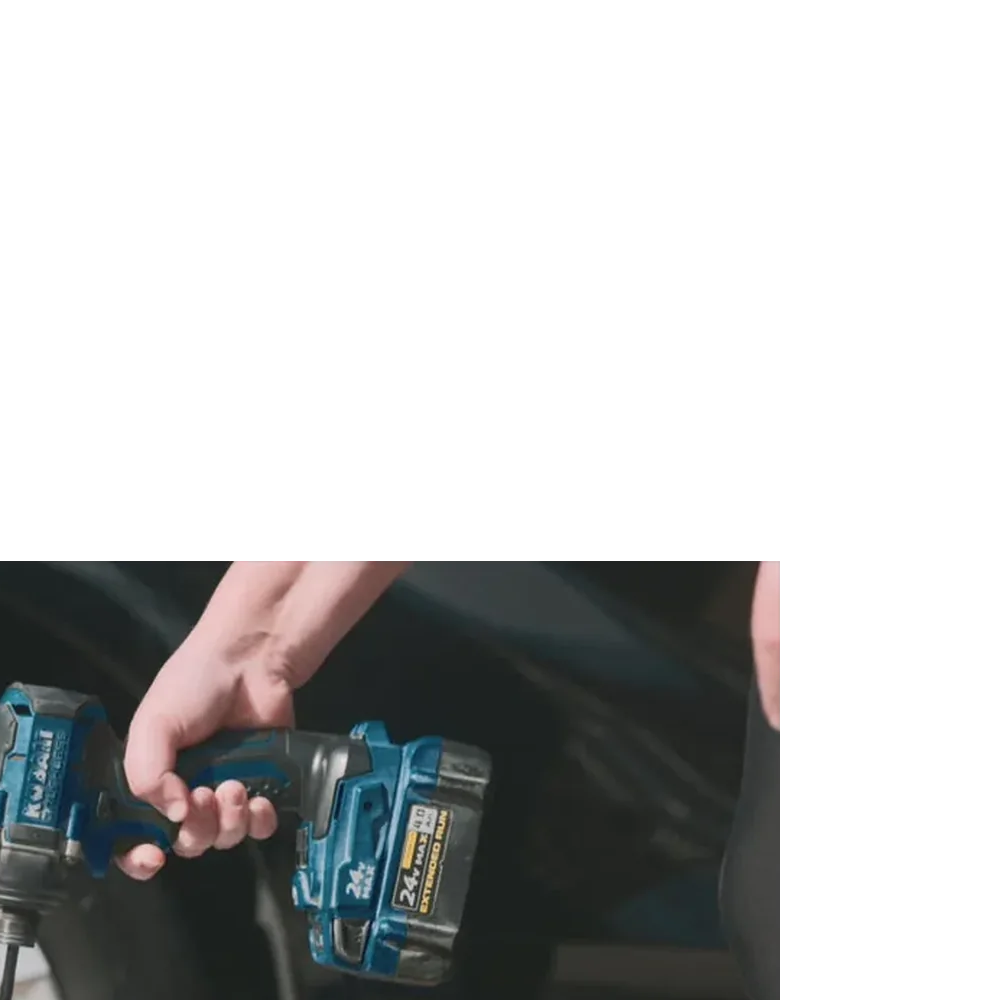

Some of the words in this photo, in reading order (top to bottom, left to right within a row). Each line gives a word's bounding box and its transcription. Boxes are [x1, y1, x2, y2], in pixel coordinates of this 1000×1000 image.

[415, 834, 427, 865] MAX
[420, 842, 441, 914] EXTENDED
[434, 810, 448, 840] RUN
